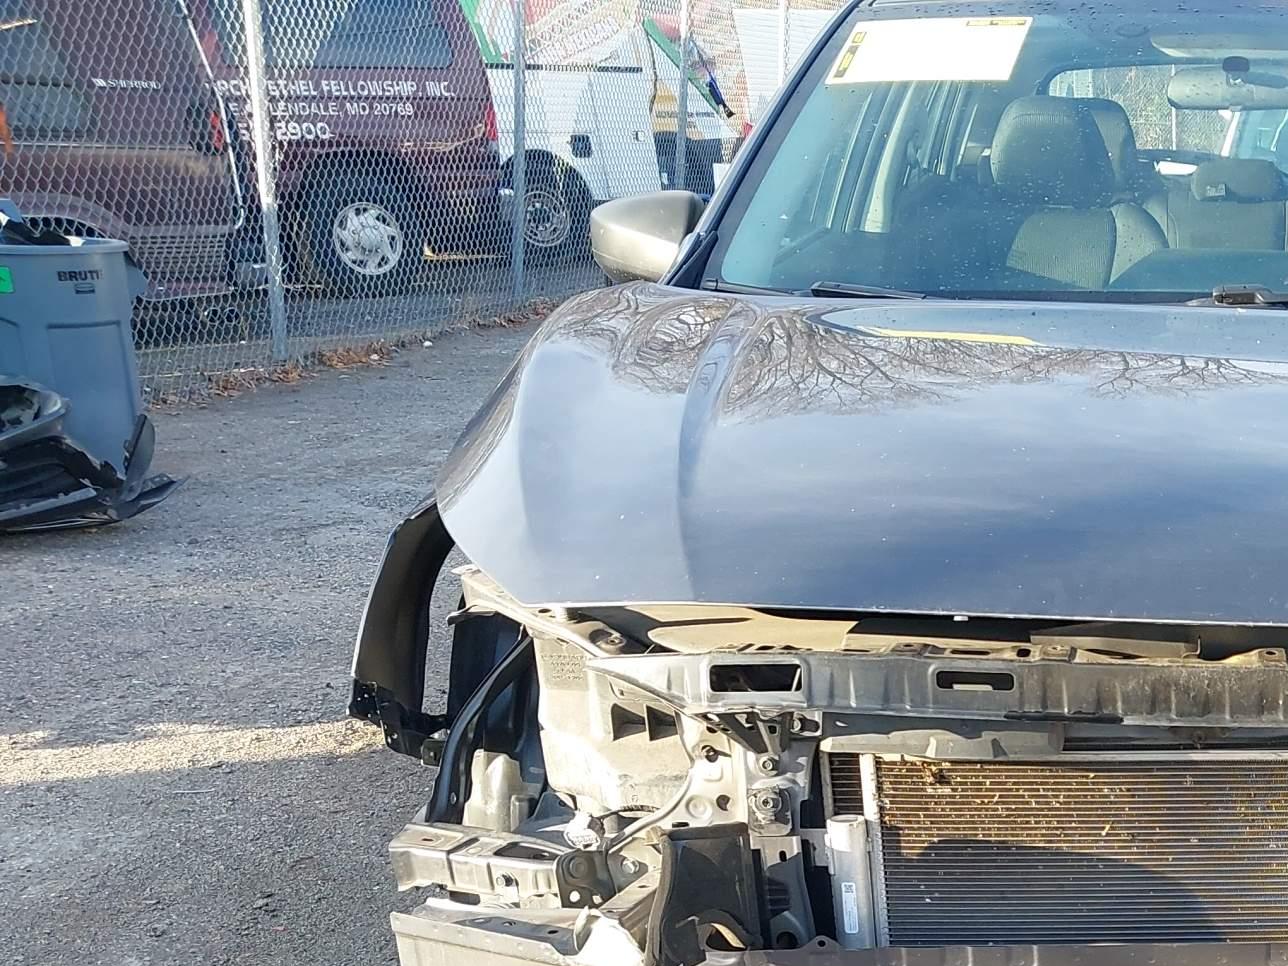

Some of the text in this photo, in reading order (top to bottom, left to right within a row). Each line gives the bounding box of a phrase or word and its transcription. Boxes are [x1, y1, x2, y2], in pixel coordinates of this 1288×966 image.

[266, 80, 318, 97] ETHEL
[269, 102, 343, 117] LENDALE,
[346, 103, 369, 115] MD
[374, 103, 414, 115] 20769
